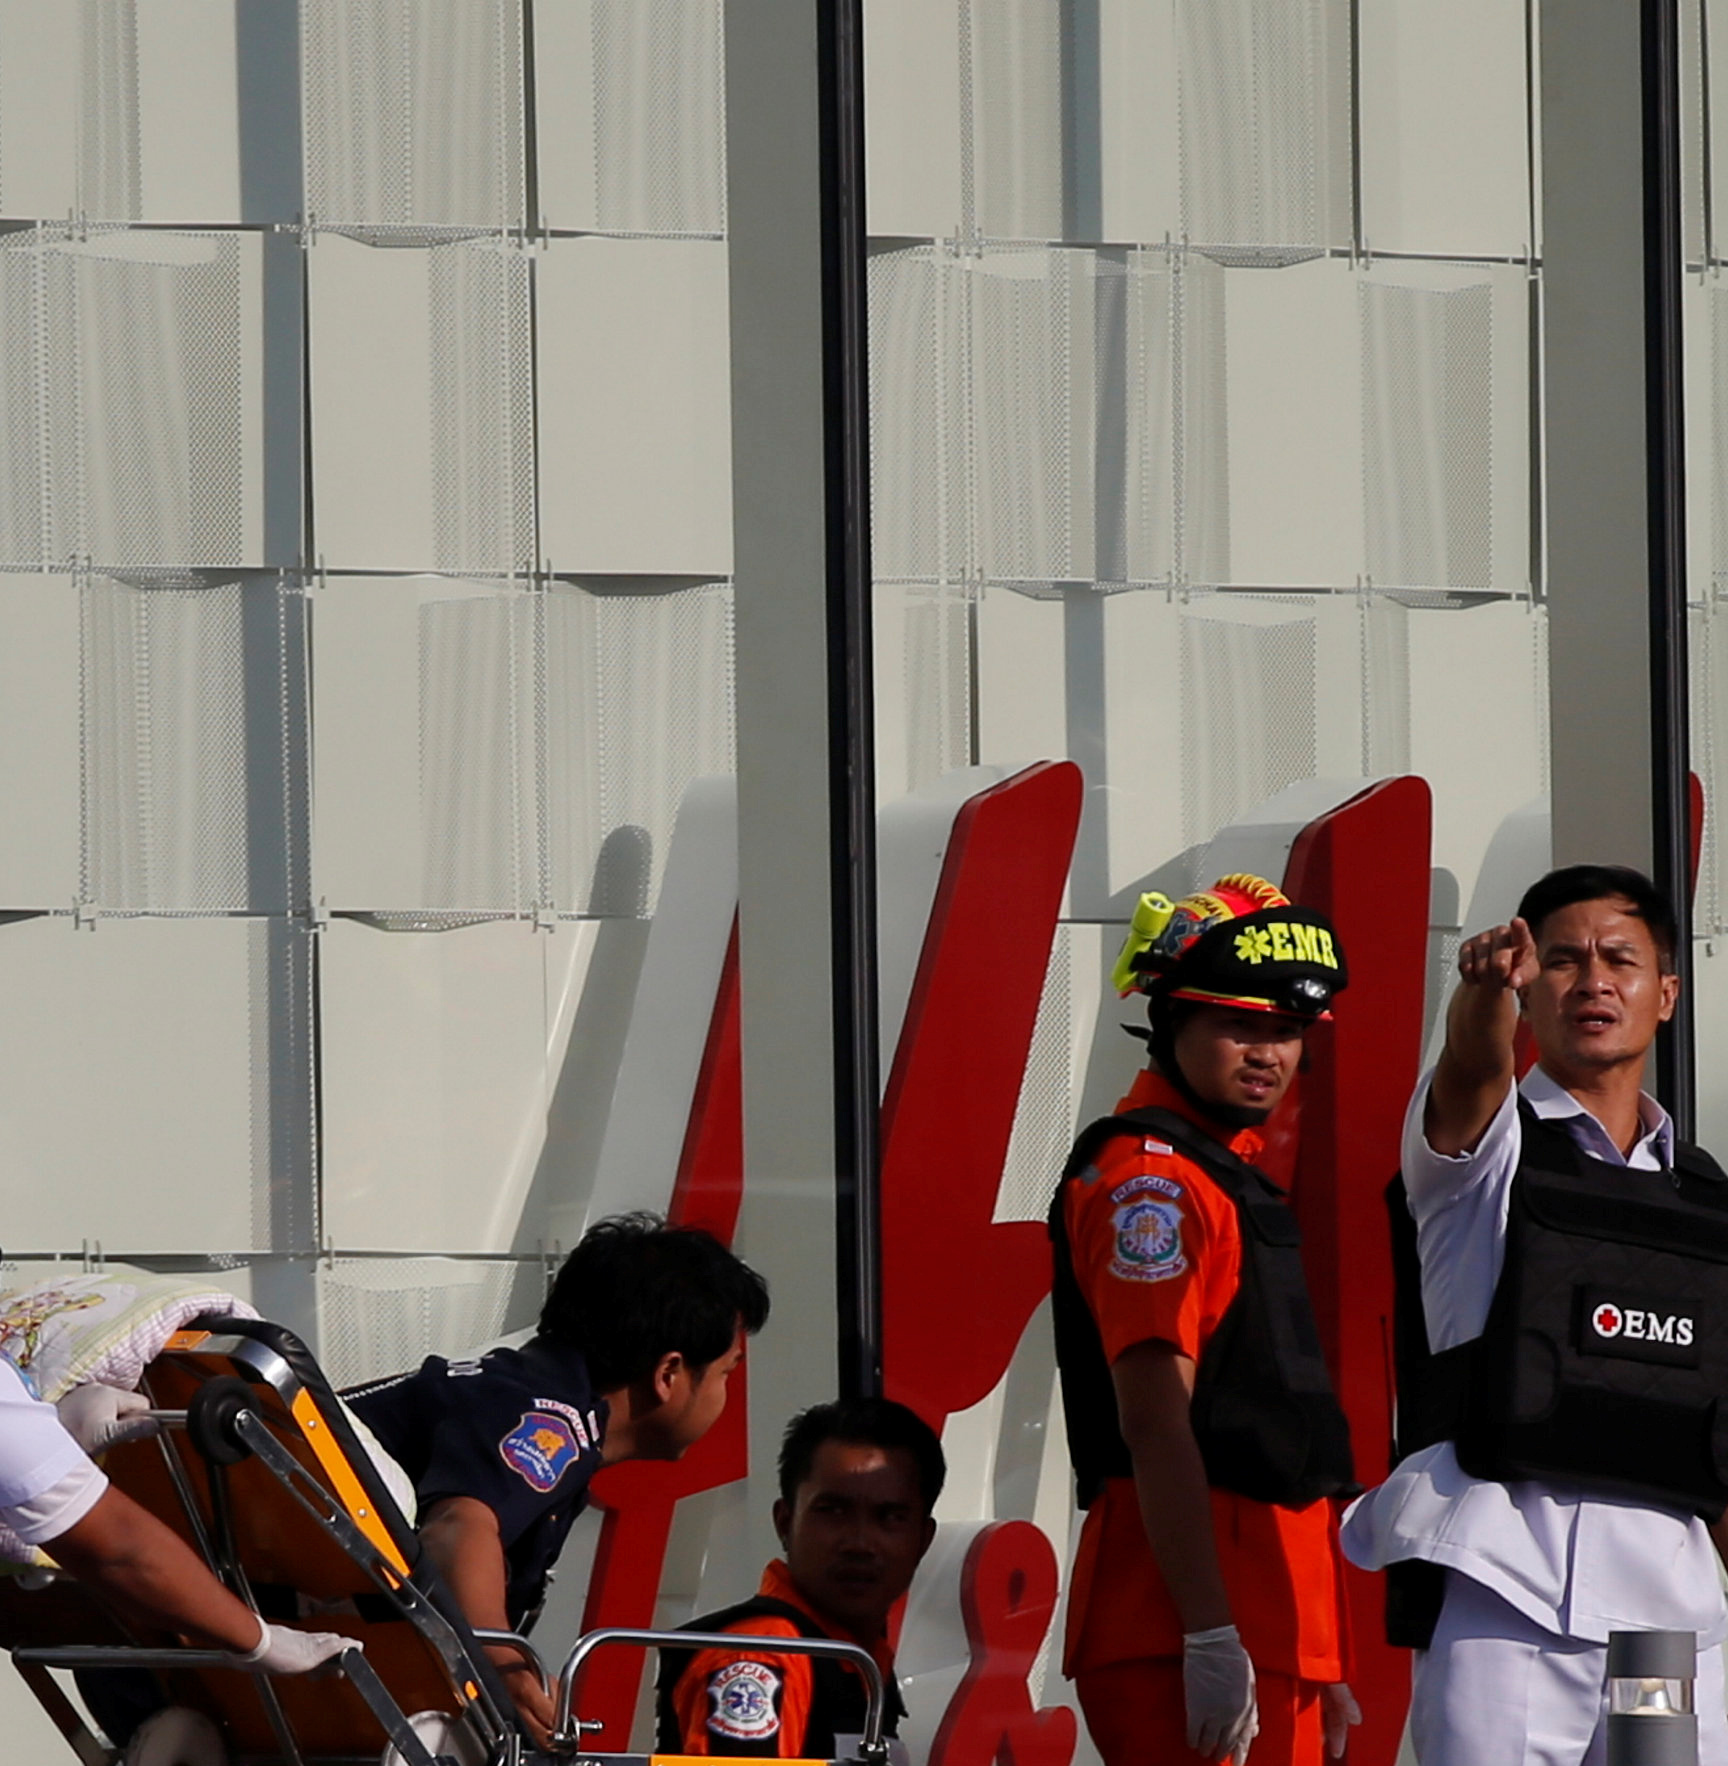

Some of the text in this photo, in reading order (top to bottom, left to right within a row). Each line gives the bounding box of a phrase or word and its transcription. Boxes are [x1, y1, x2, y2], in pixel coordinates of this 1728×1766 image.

[1267, 921, 1339, 970] EMR
[1624, 1310, 1694, 1346] EMS
[714, 1663, 773, 1689] RESCUE
